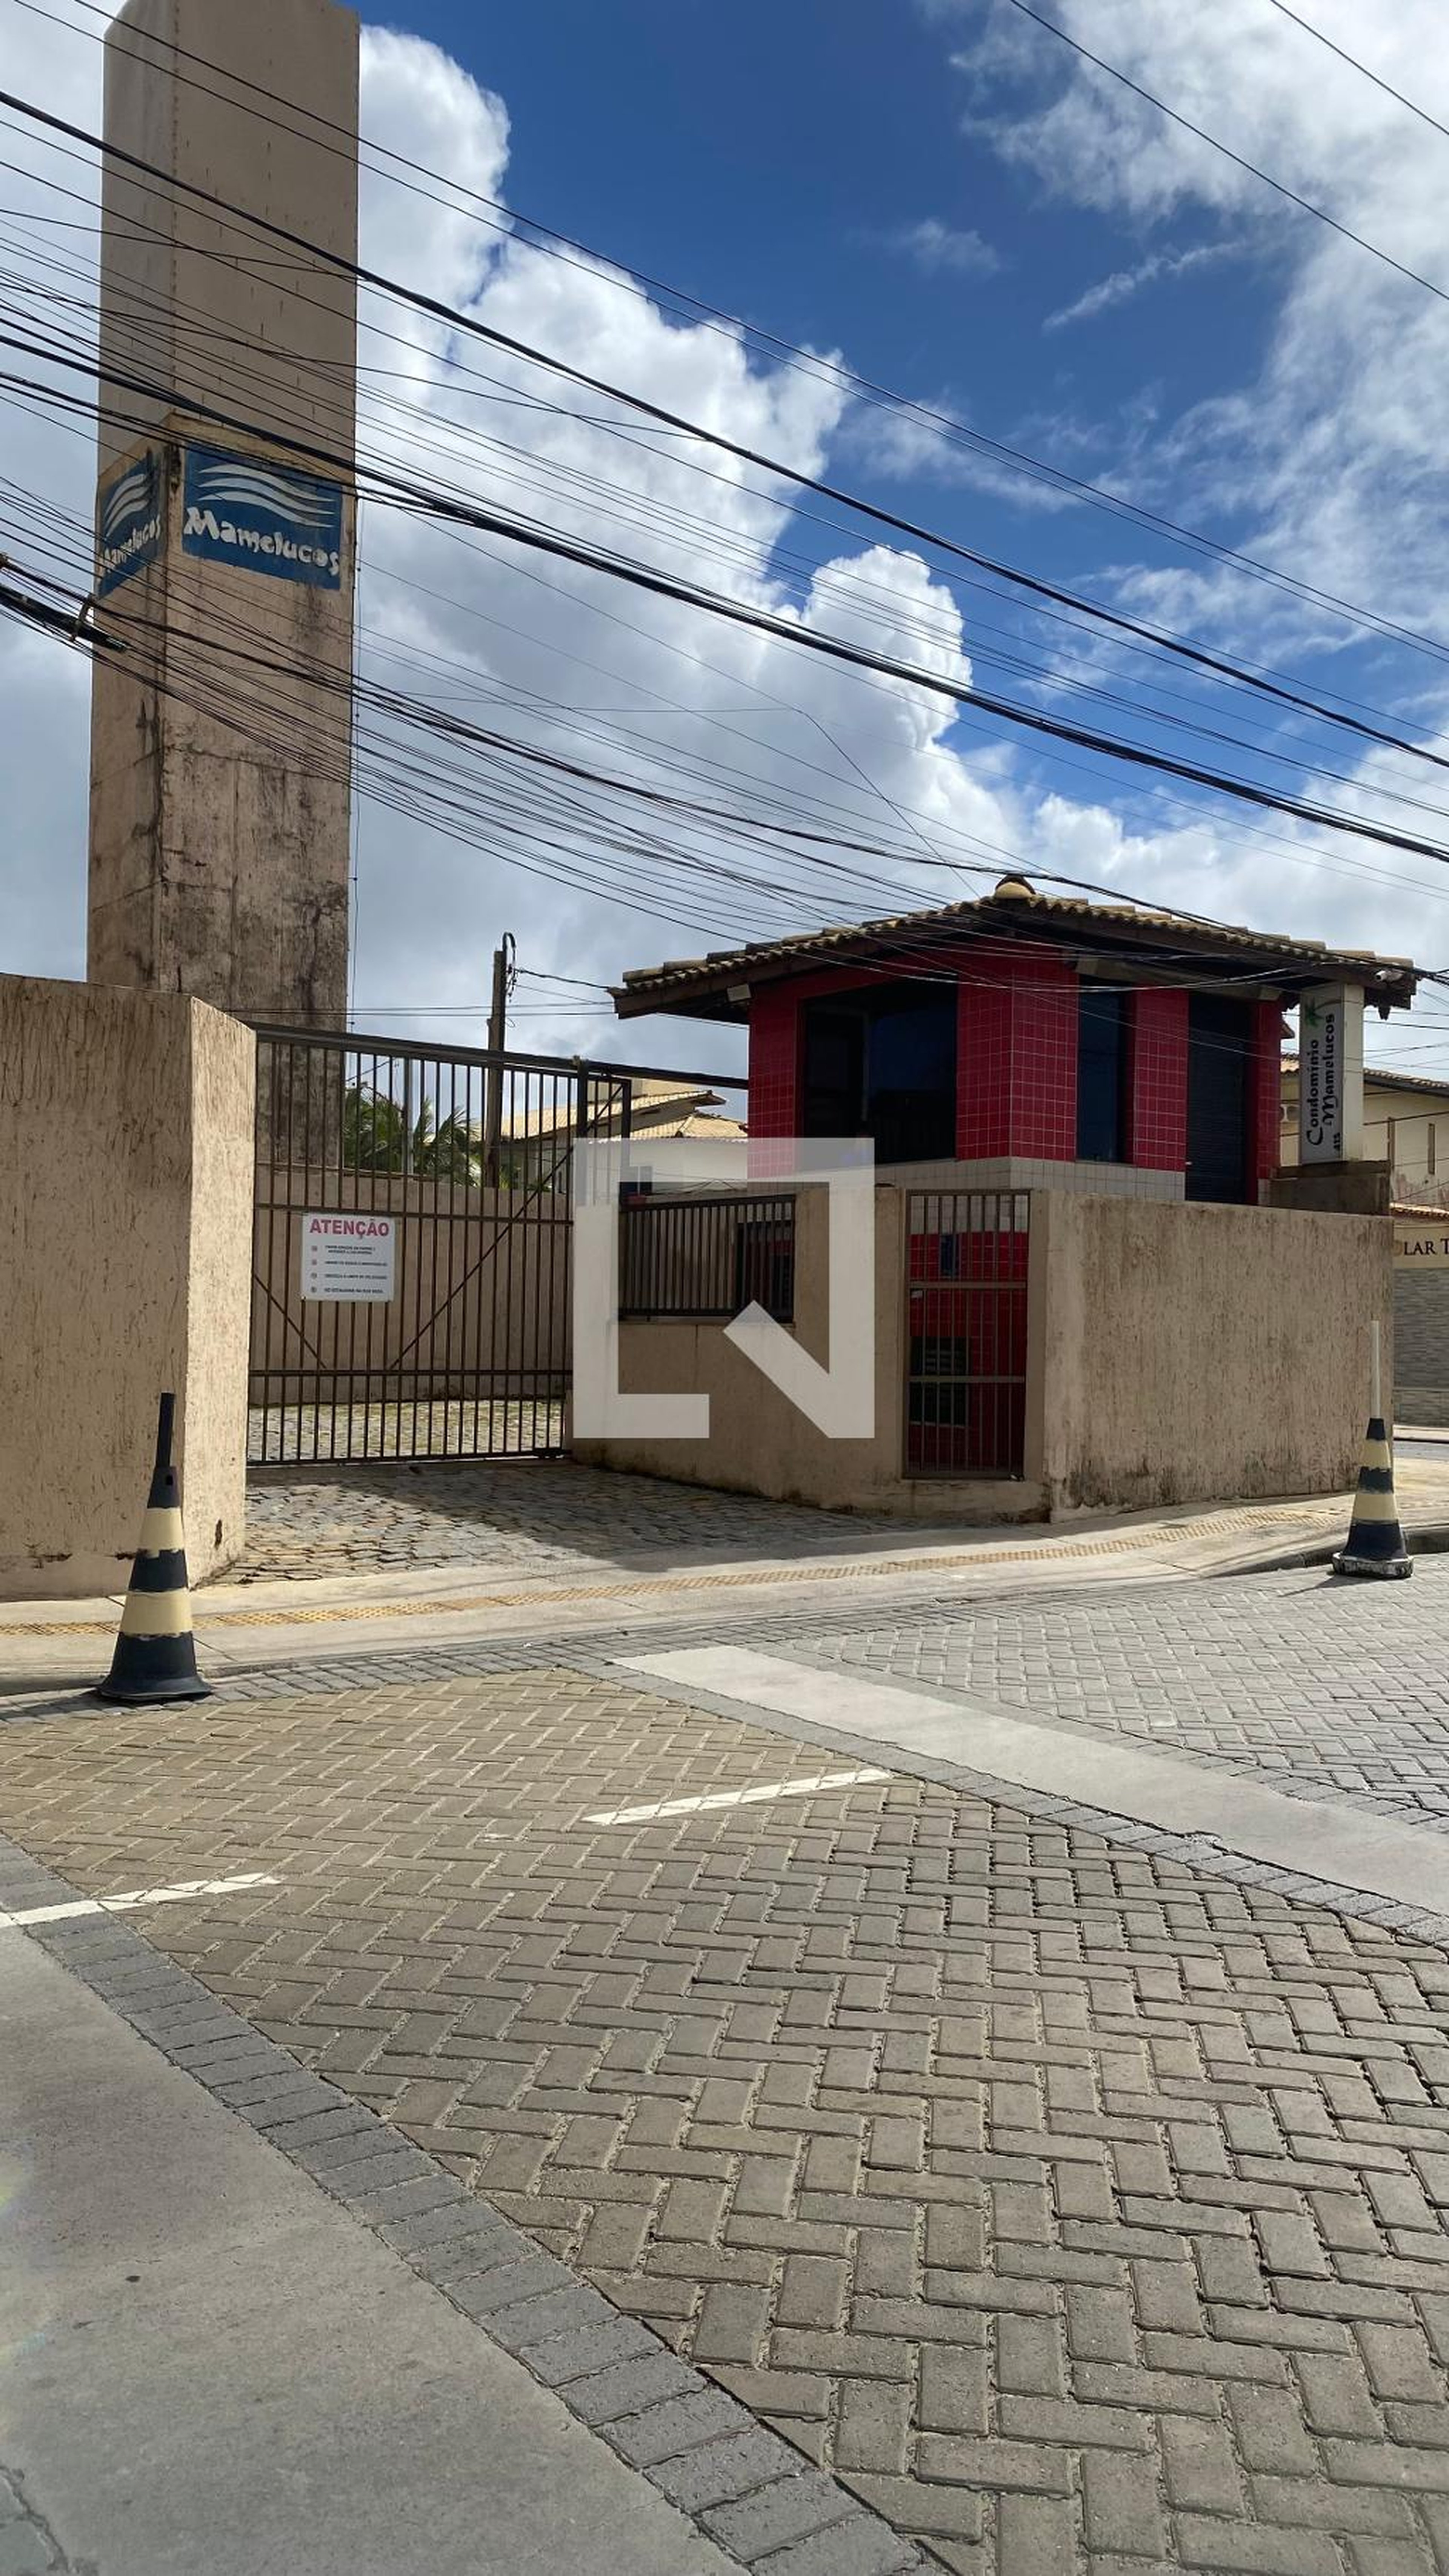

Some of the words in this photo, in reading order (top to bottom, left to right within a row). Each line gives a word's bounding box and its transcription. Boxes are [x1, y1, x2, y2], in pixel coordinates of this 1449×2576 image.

[183, 506, 340, 576] Mamelucos
[1322, 1013, 1338, 1126] Mamelucos
[310, 1219, 389, 1239] ATENÇÃO
